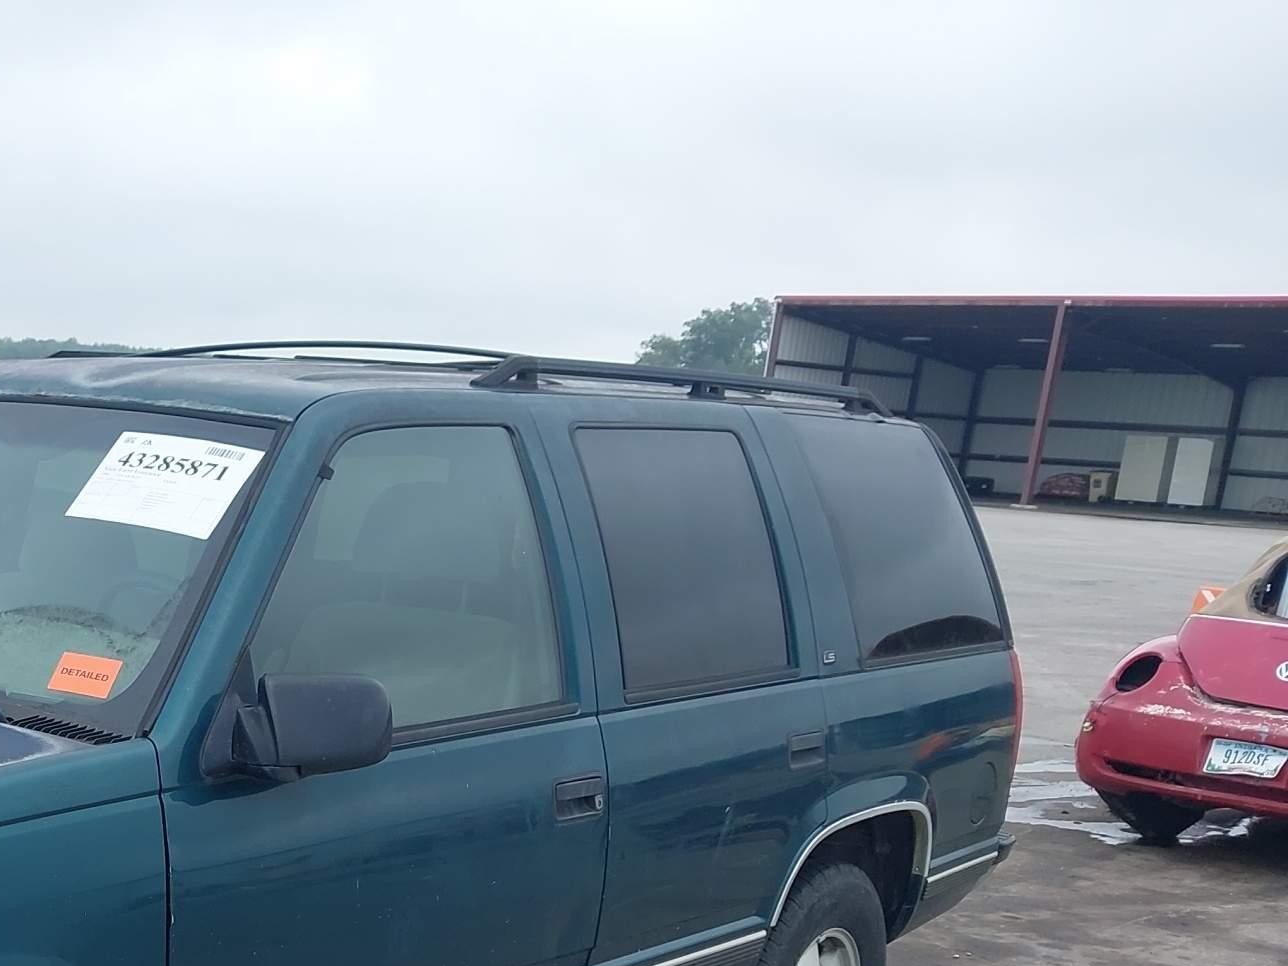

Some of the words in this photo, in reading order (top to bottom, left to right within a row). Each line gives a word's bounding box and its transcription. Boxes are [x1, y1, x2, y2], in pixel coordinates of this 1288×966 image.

[117, 450, 231, 481] 43285871
[823, 650, 836, 664] LS
[60, 667, 110, 682] DETAILED
[1222, 748, 1272, 767] 912DSF
